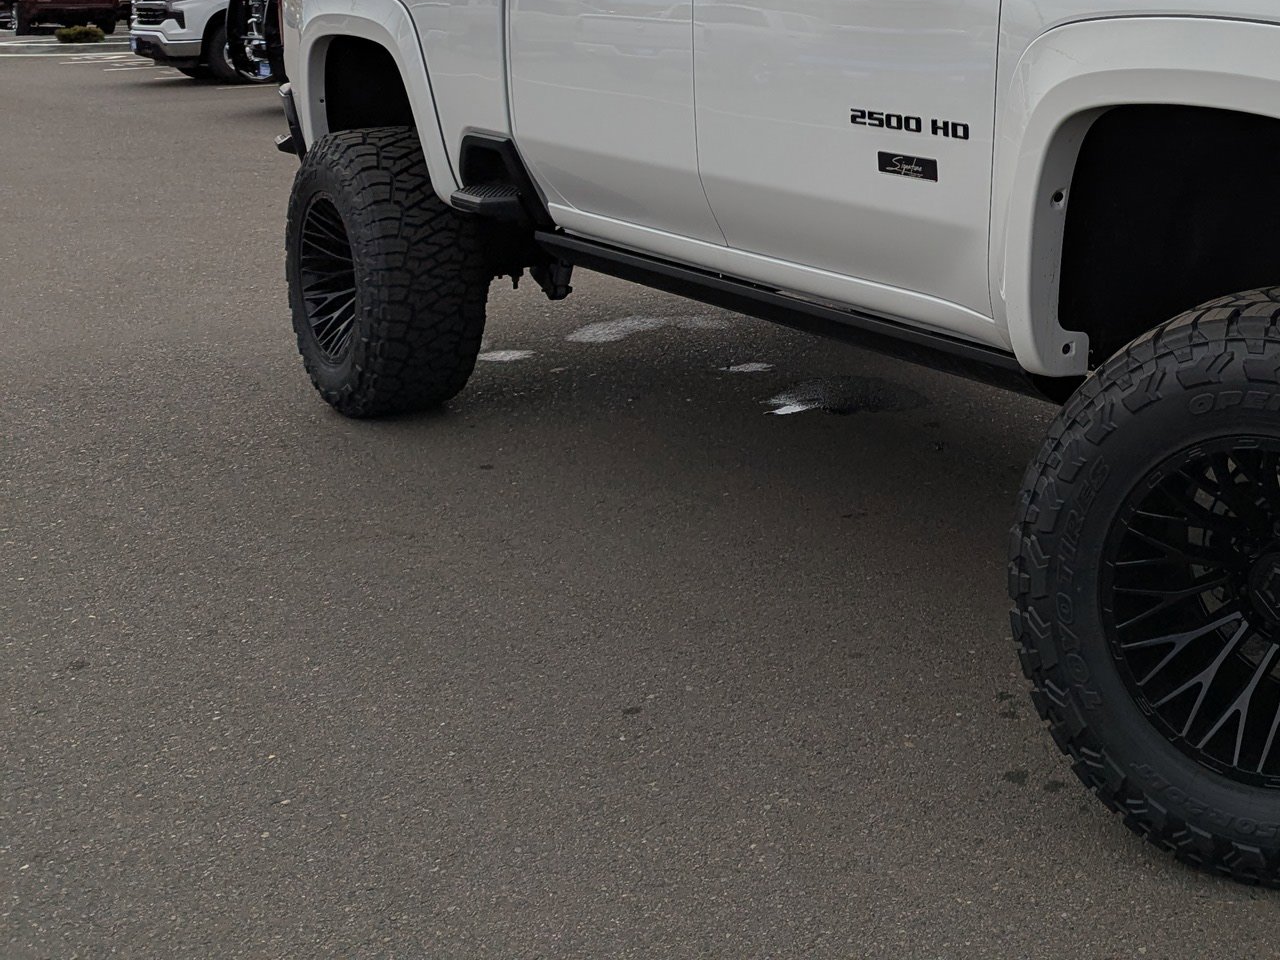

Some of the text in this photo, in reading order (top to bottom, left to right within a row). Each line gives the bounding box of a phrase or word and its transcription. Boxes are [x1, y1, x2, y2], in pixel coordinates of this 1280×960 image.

[850, 108, 970, 140] 2500 HD
[1055, 454, 1110, 713] TOYO TIRES
